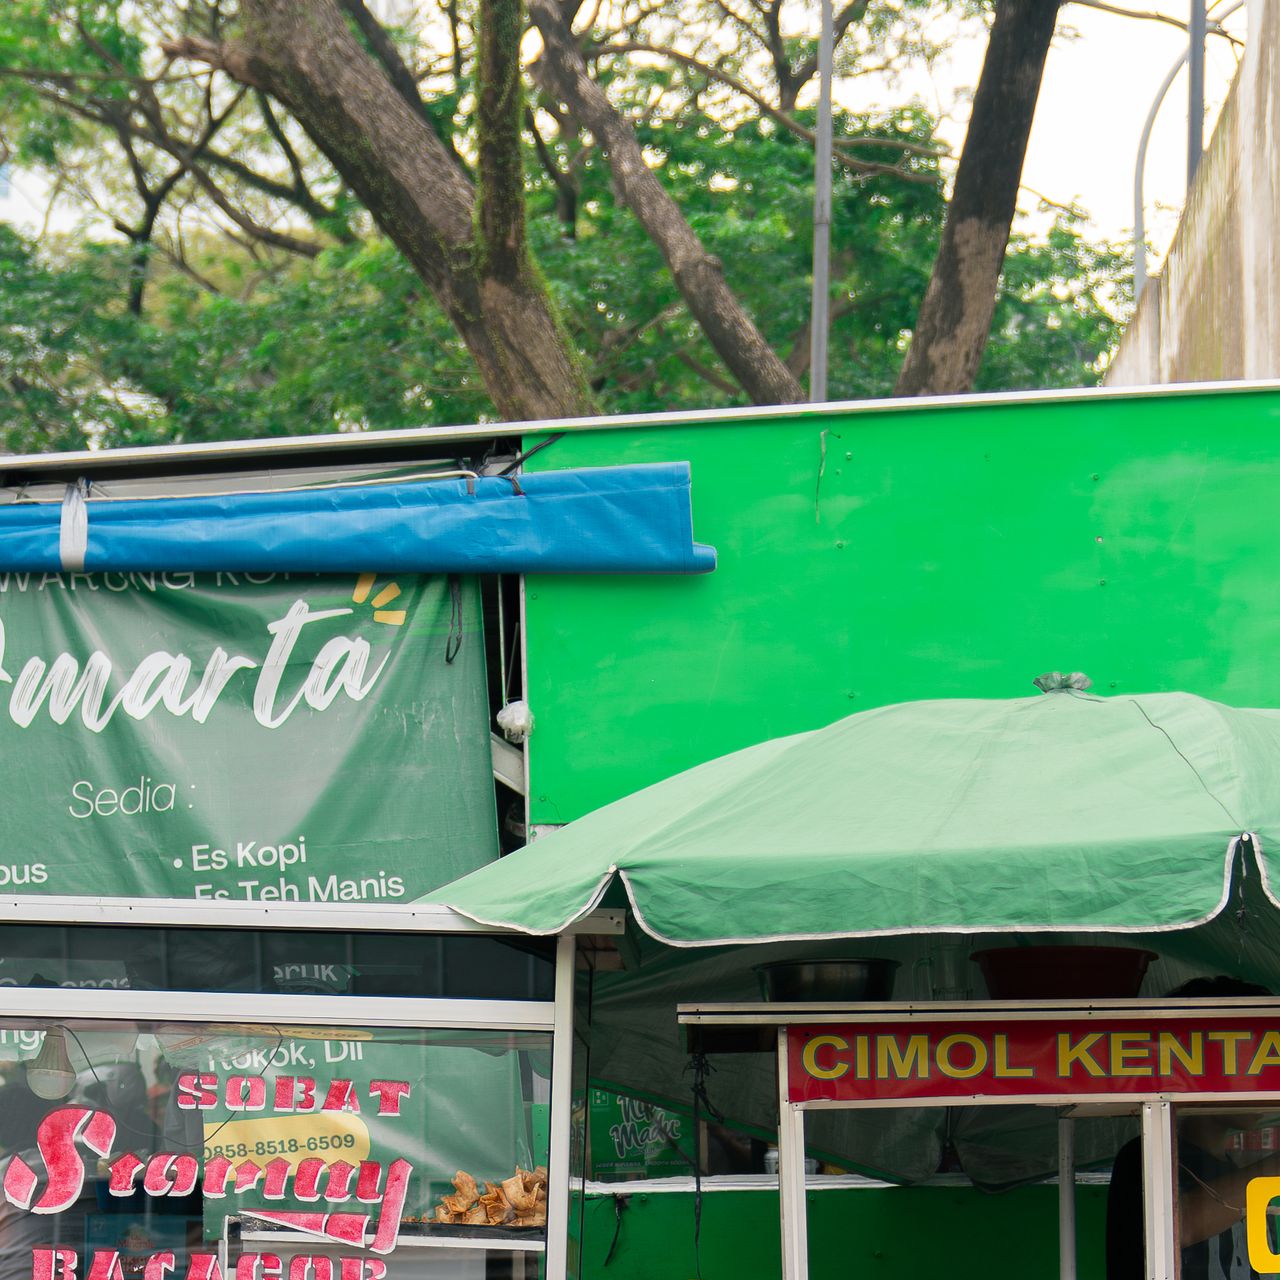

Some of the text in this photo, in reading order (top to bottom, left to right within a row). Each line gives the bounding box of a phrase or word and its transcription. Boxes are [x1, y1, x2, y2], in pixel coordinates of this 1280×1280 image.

[68, 776, 176, 819] Sedia
[191, 836, 308, 872] Es Kopi
[238, 878, 302, 901] Teh
[308, 870, 406, 901] Manis
[801, 1032, 1035, 1081] CIMOL
[177, 1072, 410, 1117] SOBAT
[205, 1134, 356, 1160] 0858-8518-6509
